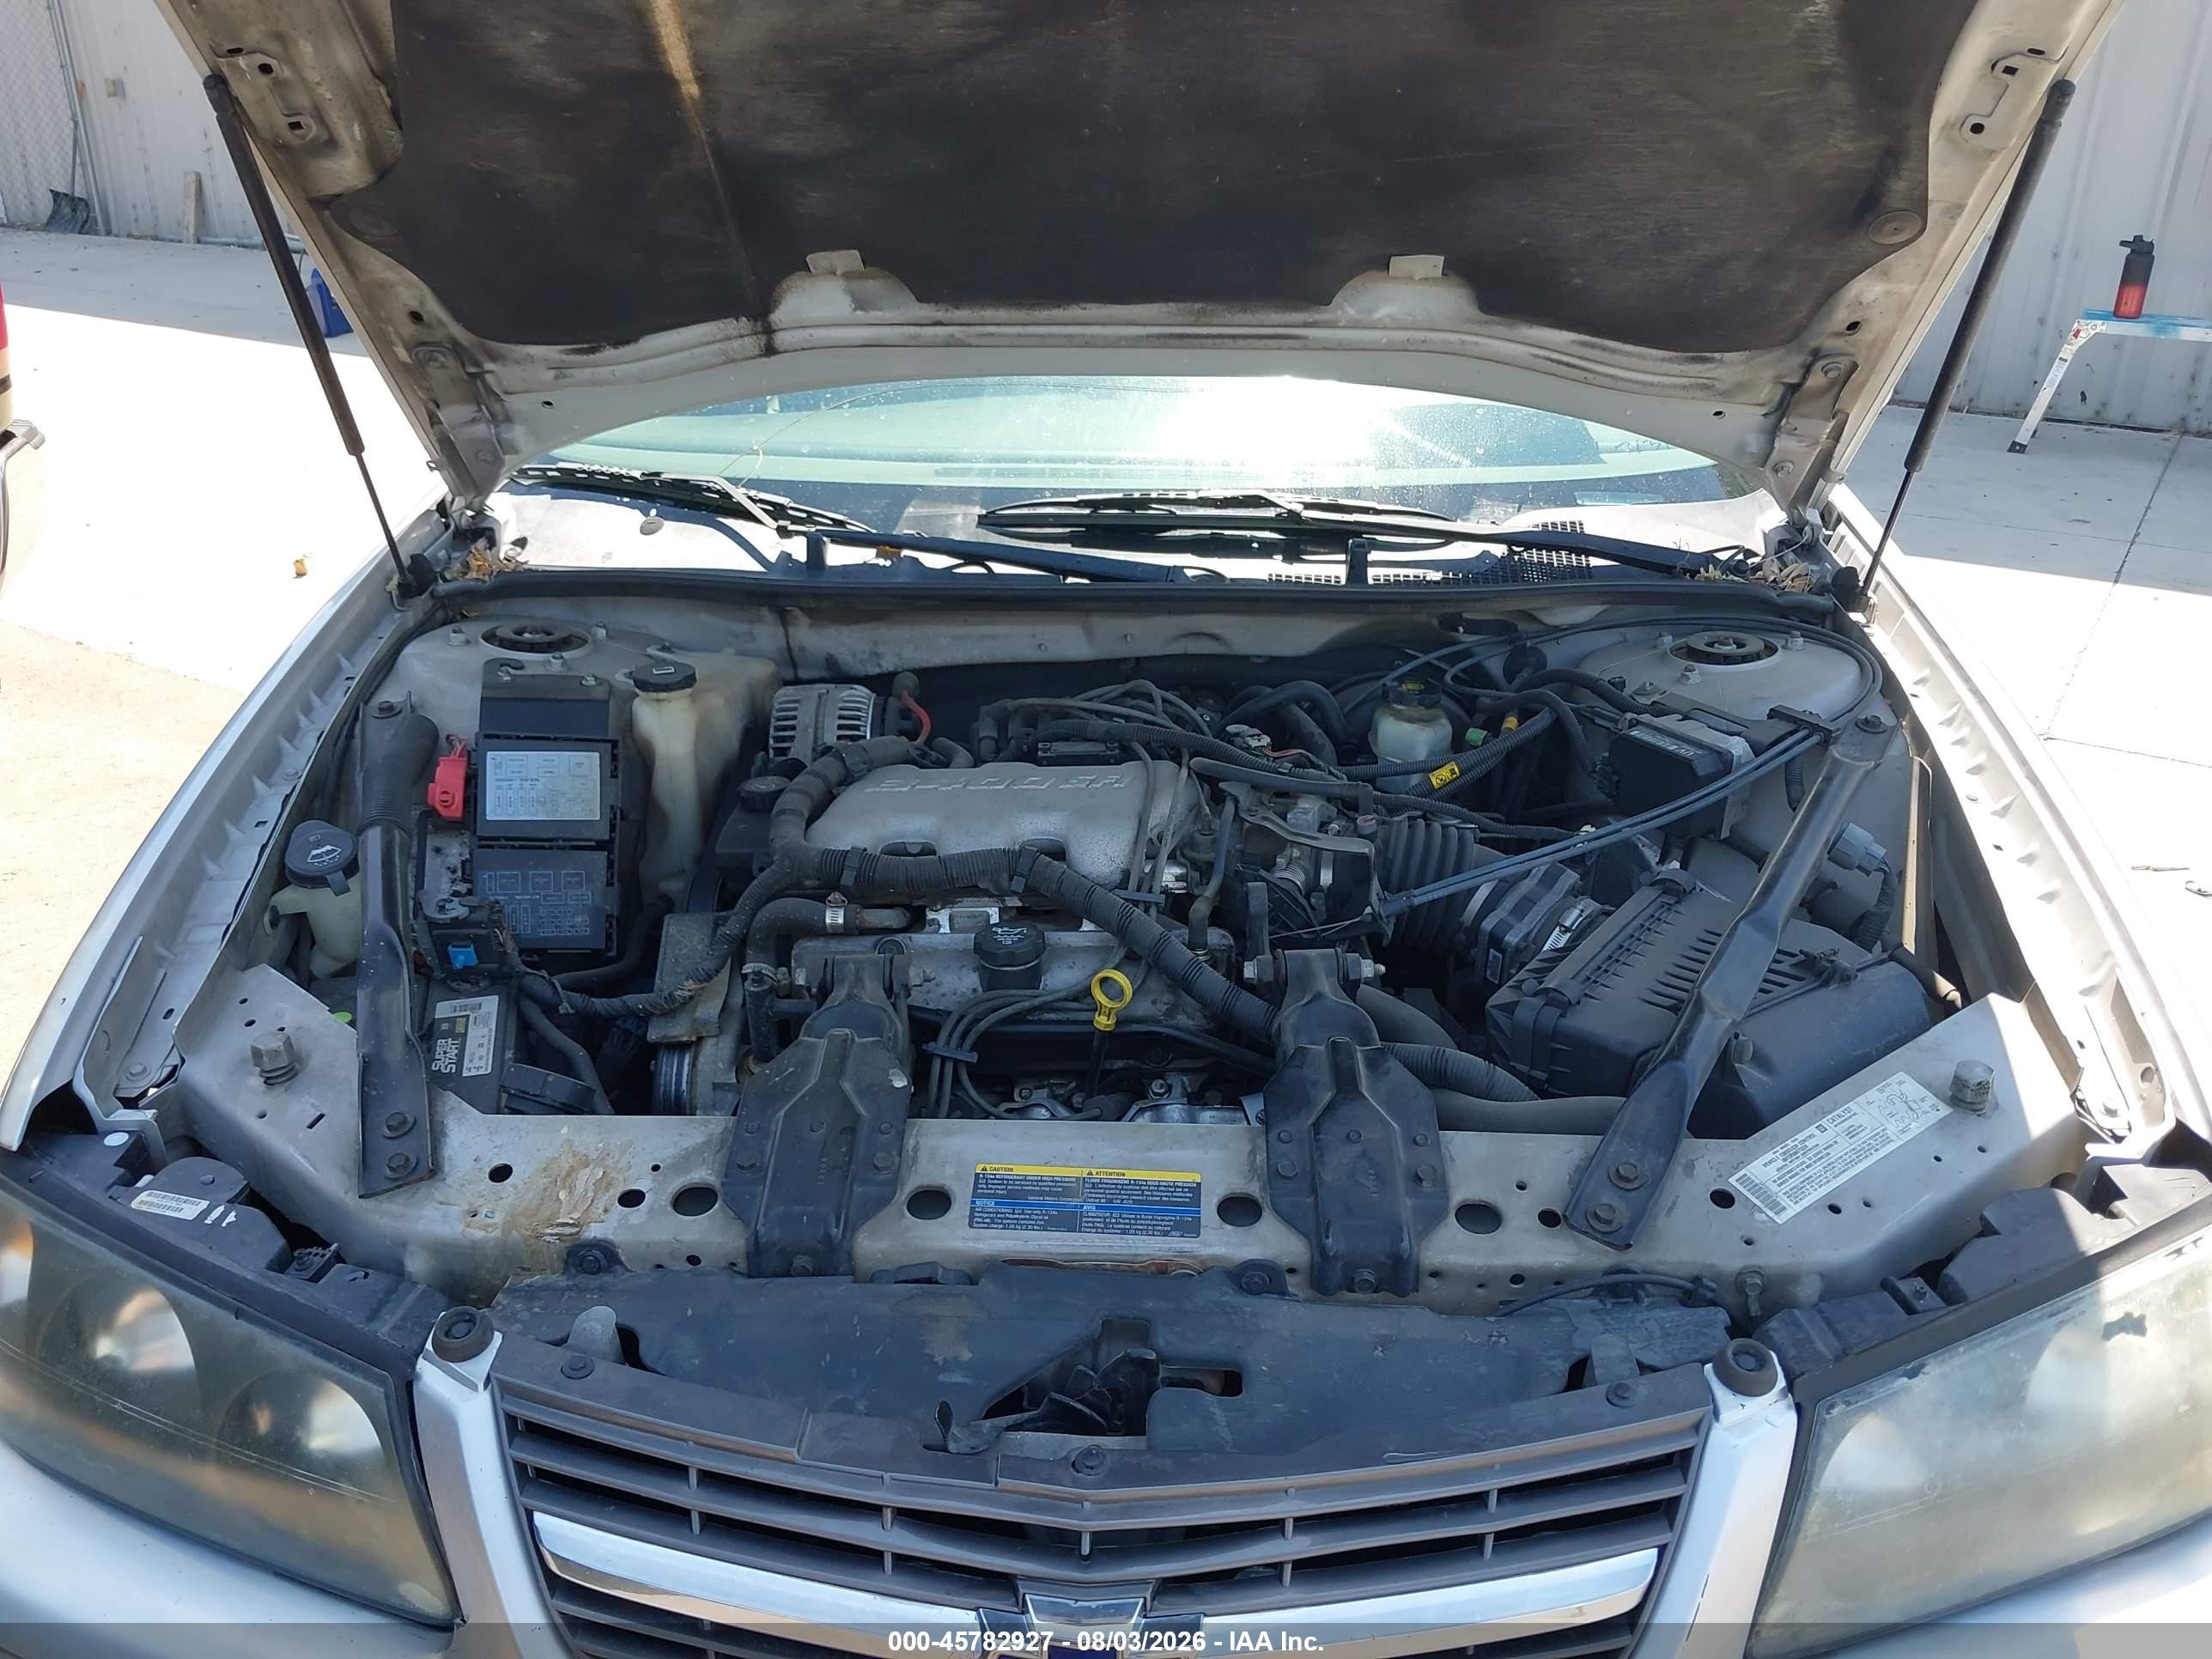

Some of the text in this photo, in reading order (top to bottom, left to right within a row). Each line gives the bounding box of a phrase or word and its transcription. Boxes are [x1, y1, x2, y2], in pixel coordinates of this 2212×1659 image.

[432, 1038, 449, 1071] SUPER
[441, 1037, 461, 1073] START
[1826, 1106, 1854, 1124] CATALYST
[1761, 1155, 1781, 1168] VEHICLE
[1797, 1133, 1816, 1146] CONTROL
